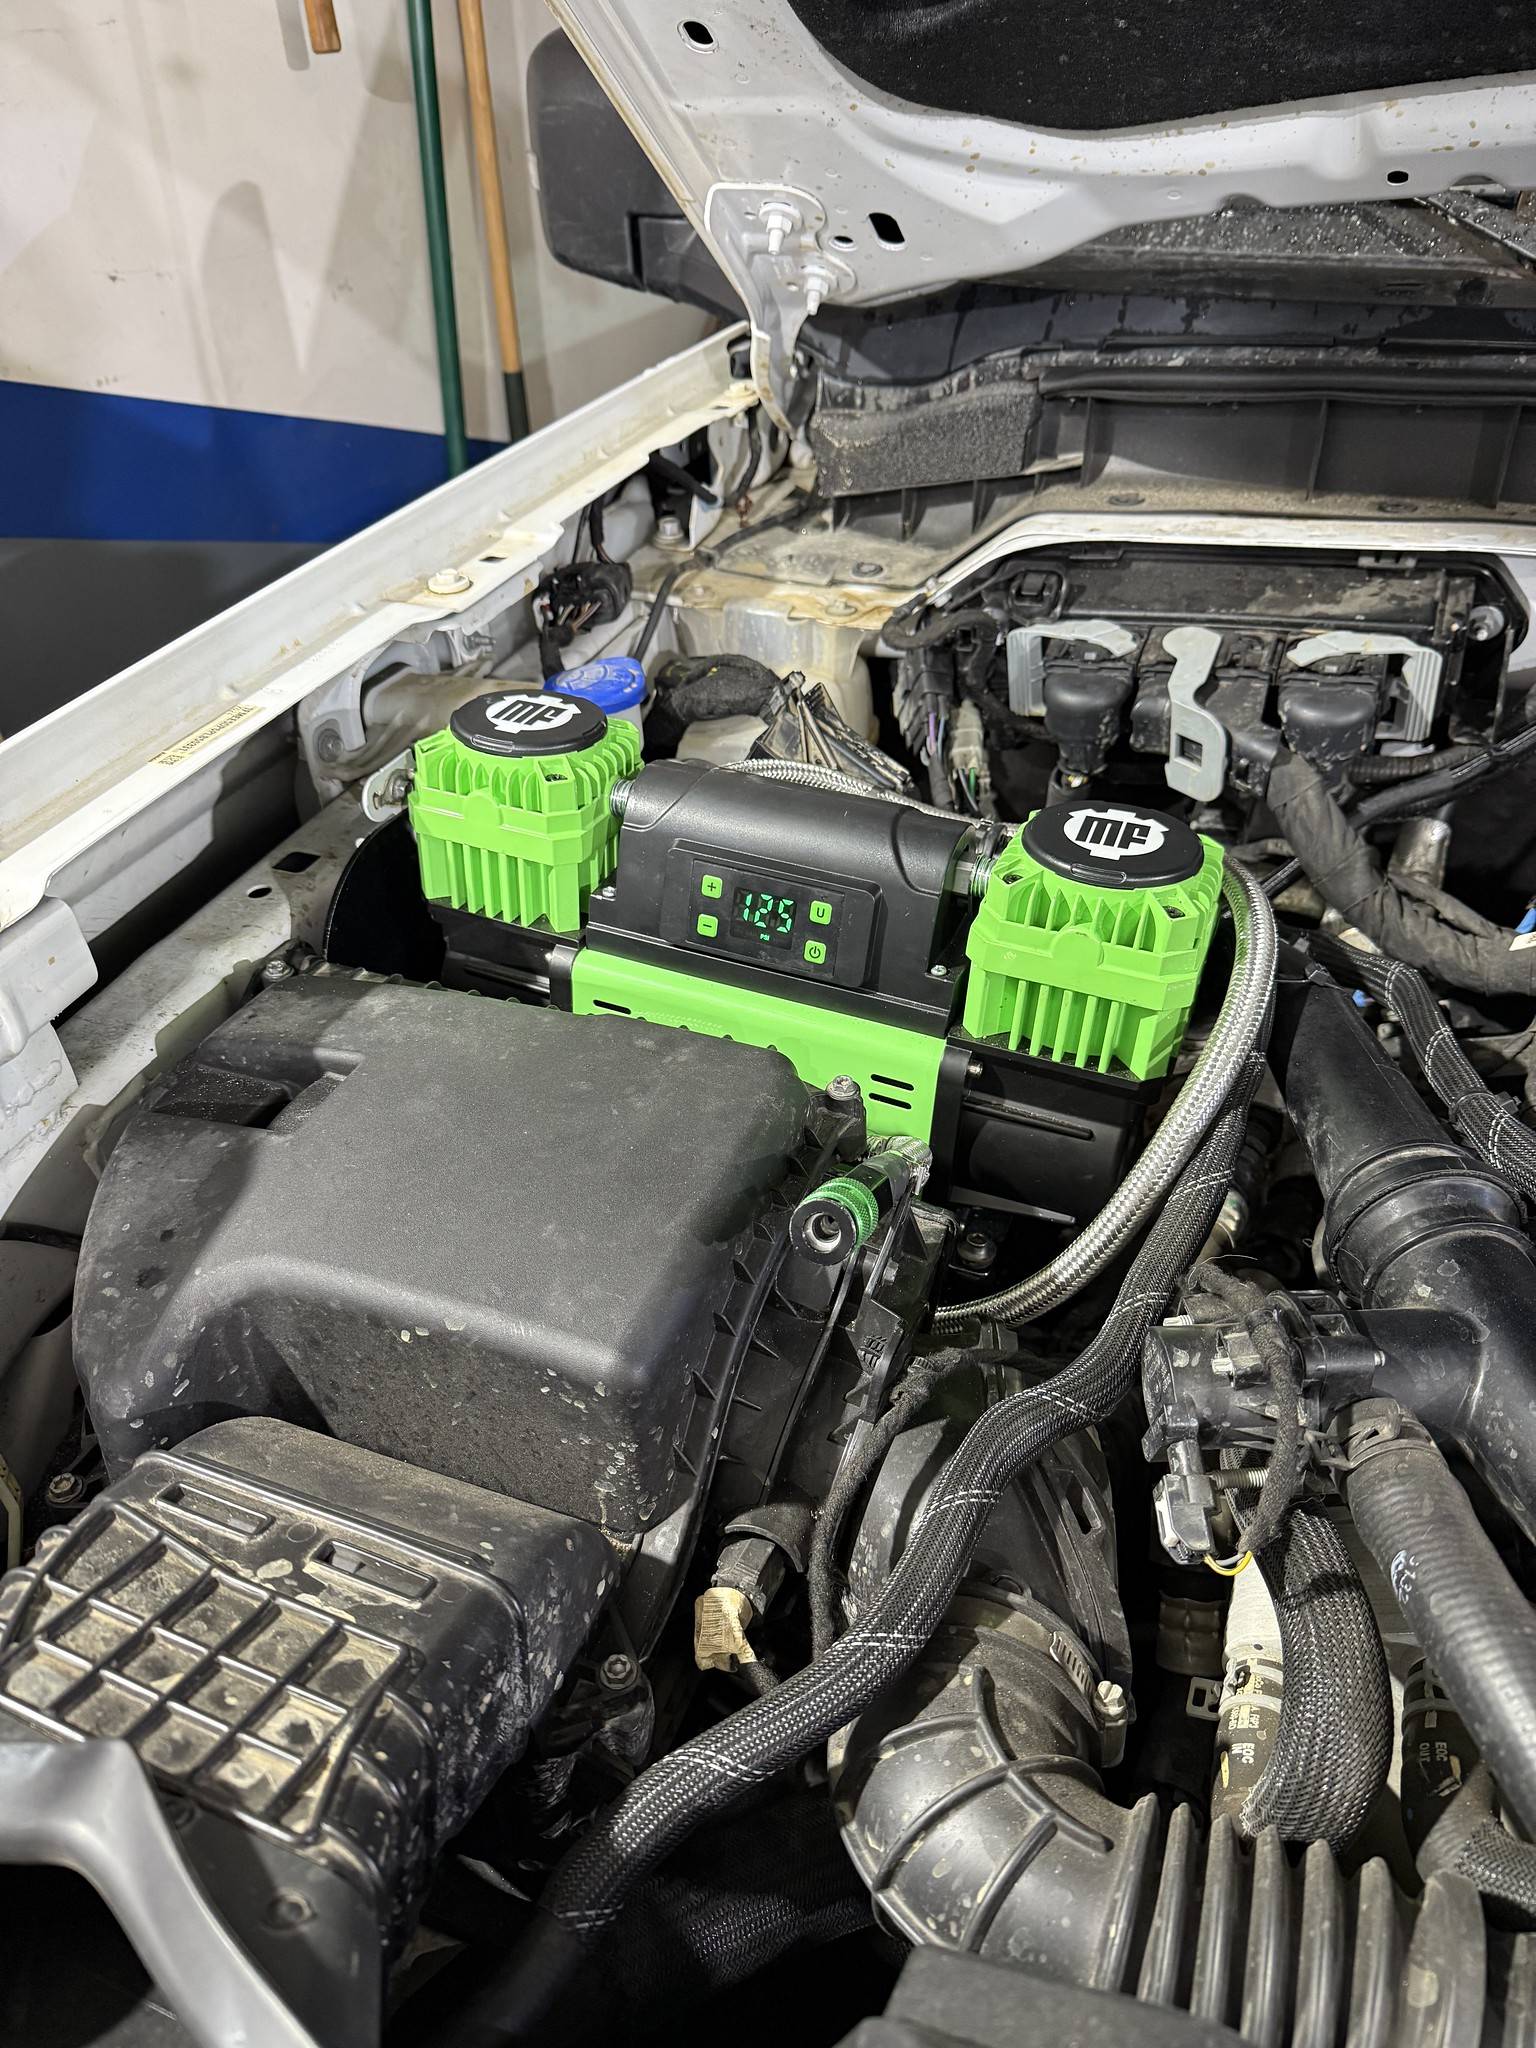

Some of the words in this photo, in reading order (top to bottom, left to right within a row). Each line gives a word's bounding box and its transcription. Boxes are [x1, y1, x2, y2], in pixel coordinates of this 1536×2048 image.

[491, 699, 568, 726] MF
[1075, 815, 1151, 850] MF
[742, 893, 794, 933] 125
[816, 907, 825, 919] U
[1231, 1742, 1242, 1755] IN
[1419, 1742, 1430, 1762] OUT
